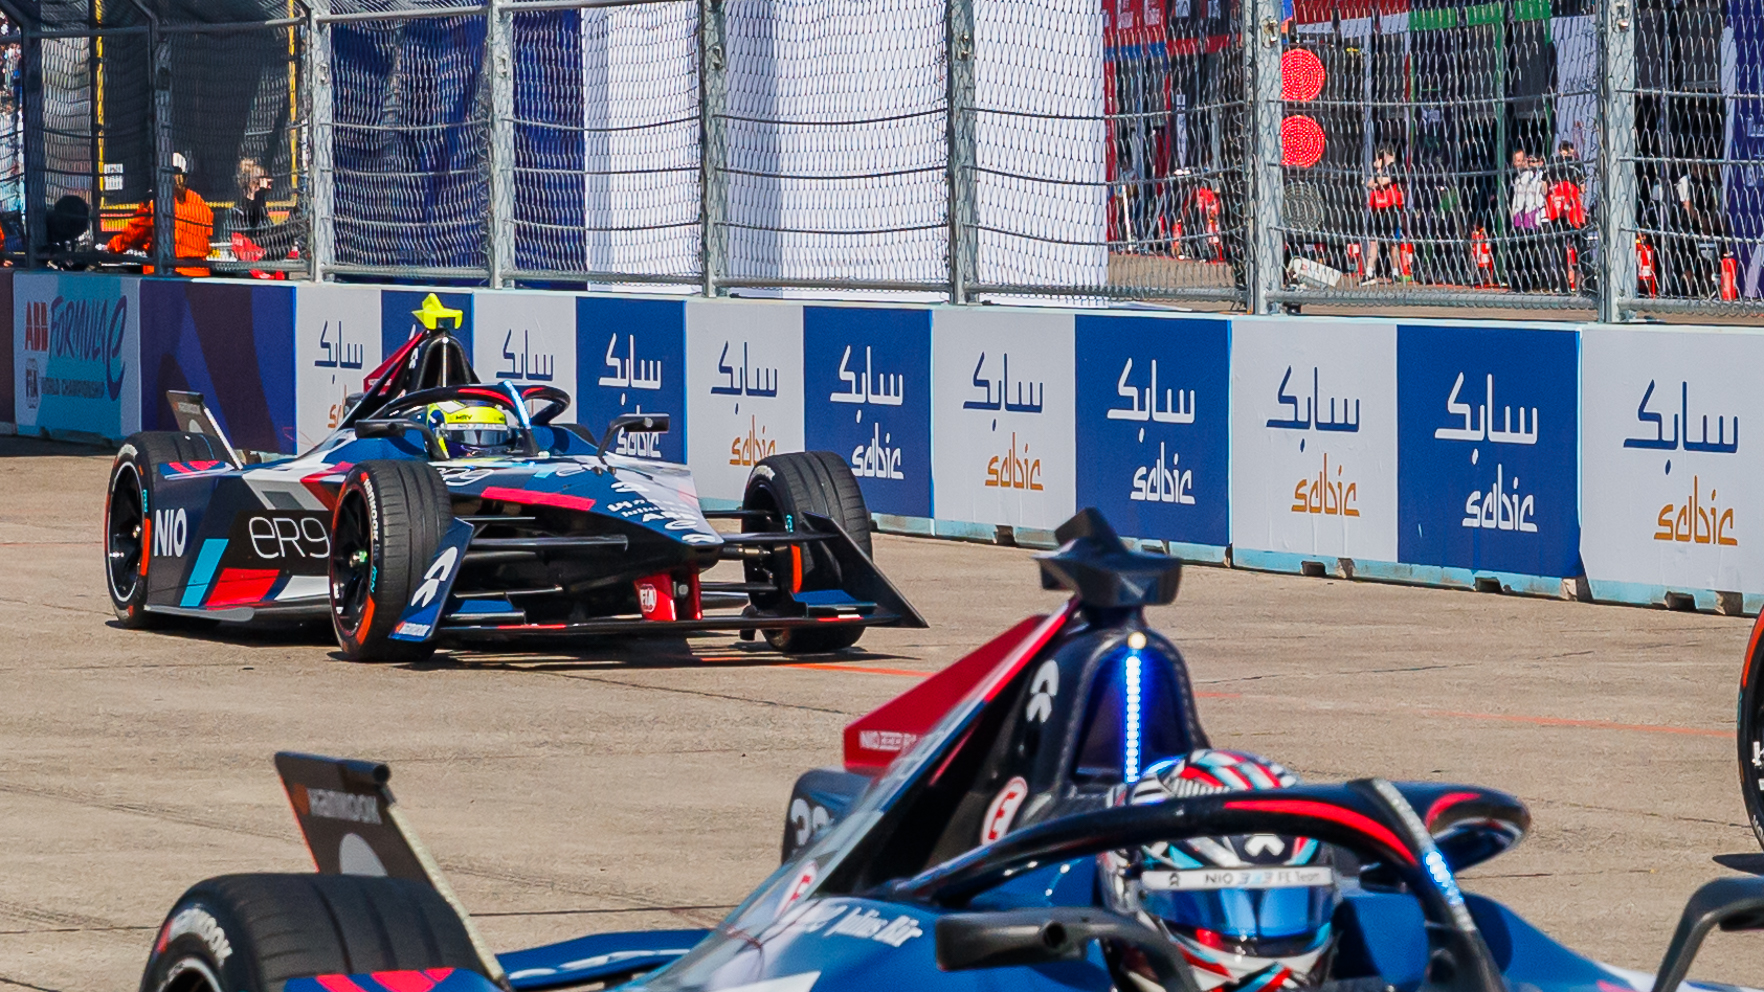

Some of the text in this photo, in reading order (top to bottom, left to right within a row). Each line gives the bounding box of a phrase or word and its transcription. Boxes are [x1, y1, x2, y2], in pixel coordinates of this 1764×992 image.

[24, 301, 49, 352] ABB
[314, 320, 363, 385] سابك
[599, 332, 662, 406] سابك
[710, 340, 778, 415] سابك
[830, 344, 904, 421] سابك
[962, 351, 1044, 432] سابك
[1107, 357, 1197, 442] سابك
[1266, 365, 1361, 453] سابك
[1435, 371, 1538, 465] سابك
[1623, 379, 1739, 475] سابك
[852, 422, 905, 481] sabic
[985, 431, 1044, 492] sabic
[1130, 441, 1197, 506] sabic
[1290, 453, 1361, 519] sabic
[153, 507, 188, 558] NIO
[1463, 464, 1538, 534] sabic
[1654, 475, 1739, 548] sabic
